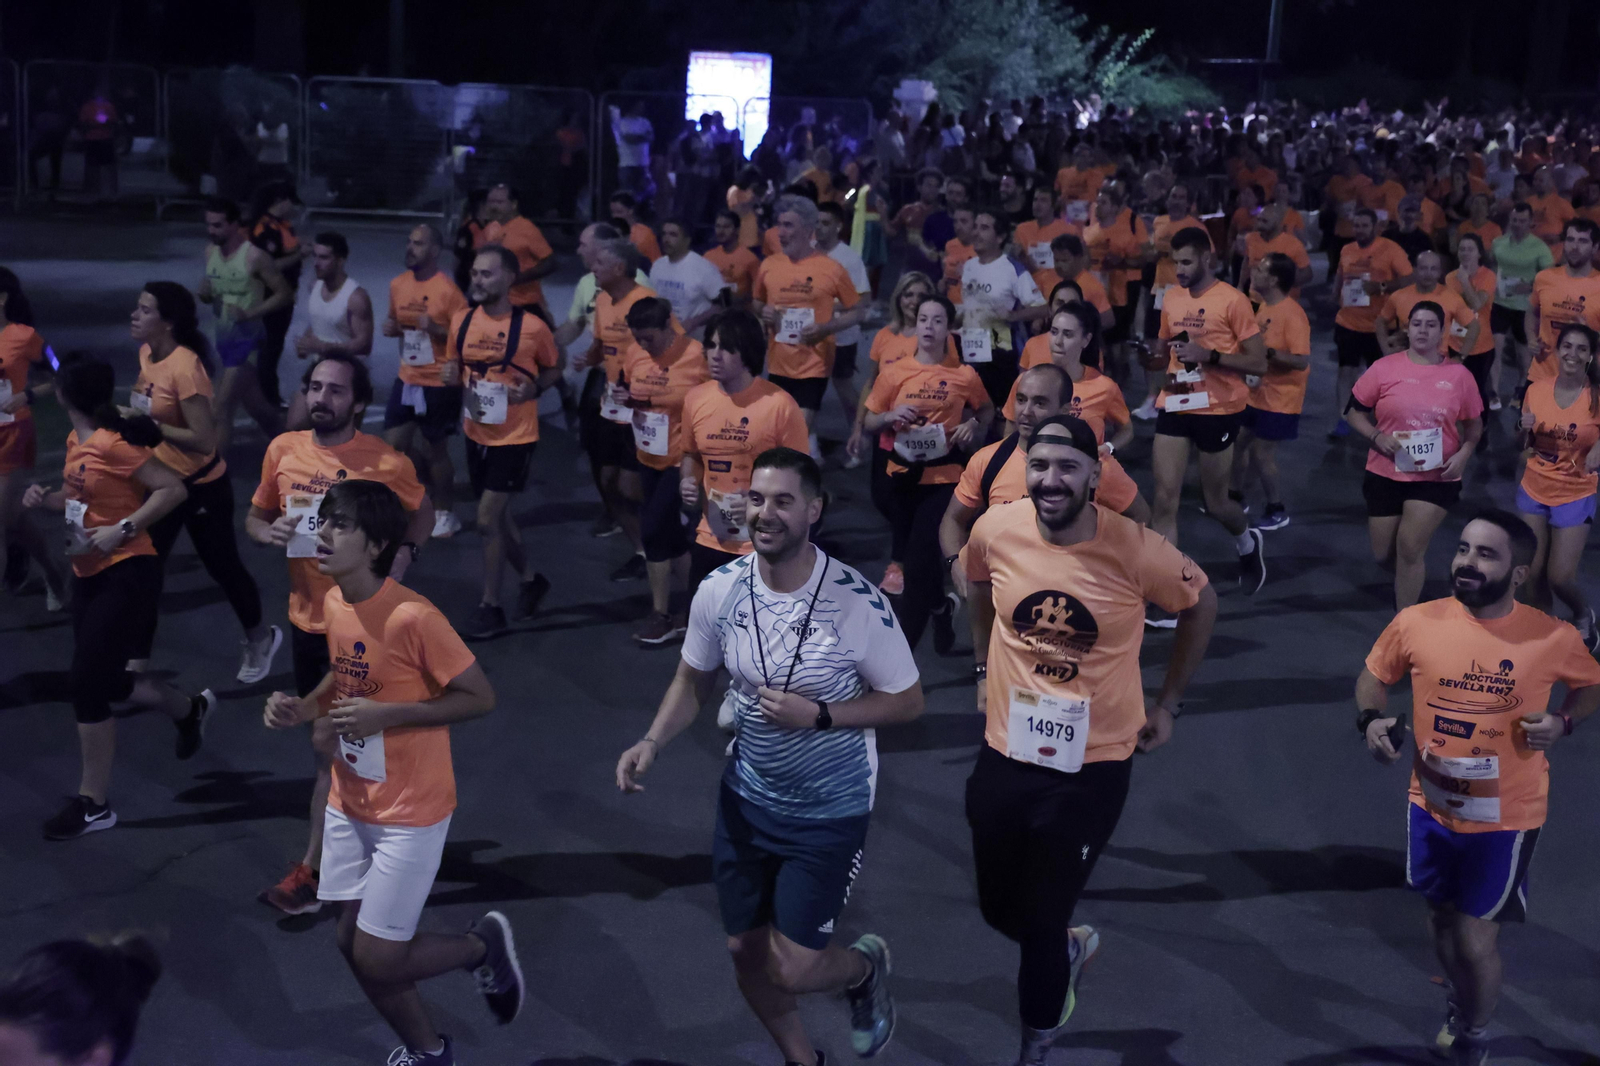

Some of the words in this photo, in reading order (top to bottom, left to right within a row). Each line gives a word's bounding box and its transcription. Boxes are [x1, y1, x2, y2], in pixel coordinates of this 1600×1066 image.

[905, 440, 937, 450] 13959
[1405, 443, 1435, 455] 11837
[290, 482, 324, 495] SEVILLA
[335, 655, 370, 670] NOCTURNA
[1438, 678, 1485, 693] SEVILLA
[1462, 672, 1516, 687] NOCTURNA
[1027, 715, 1075, 743] 14979
